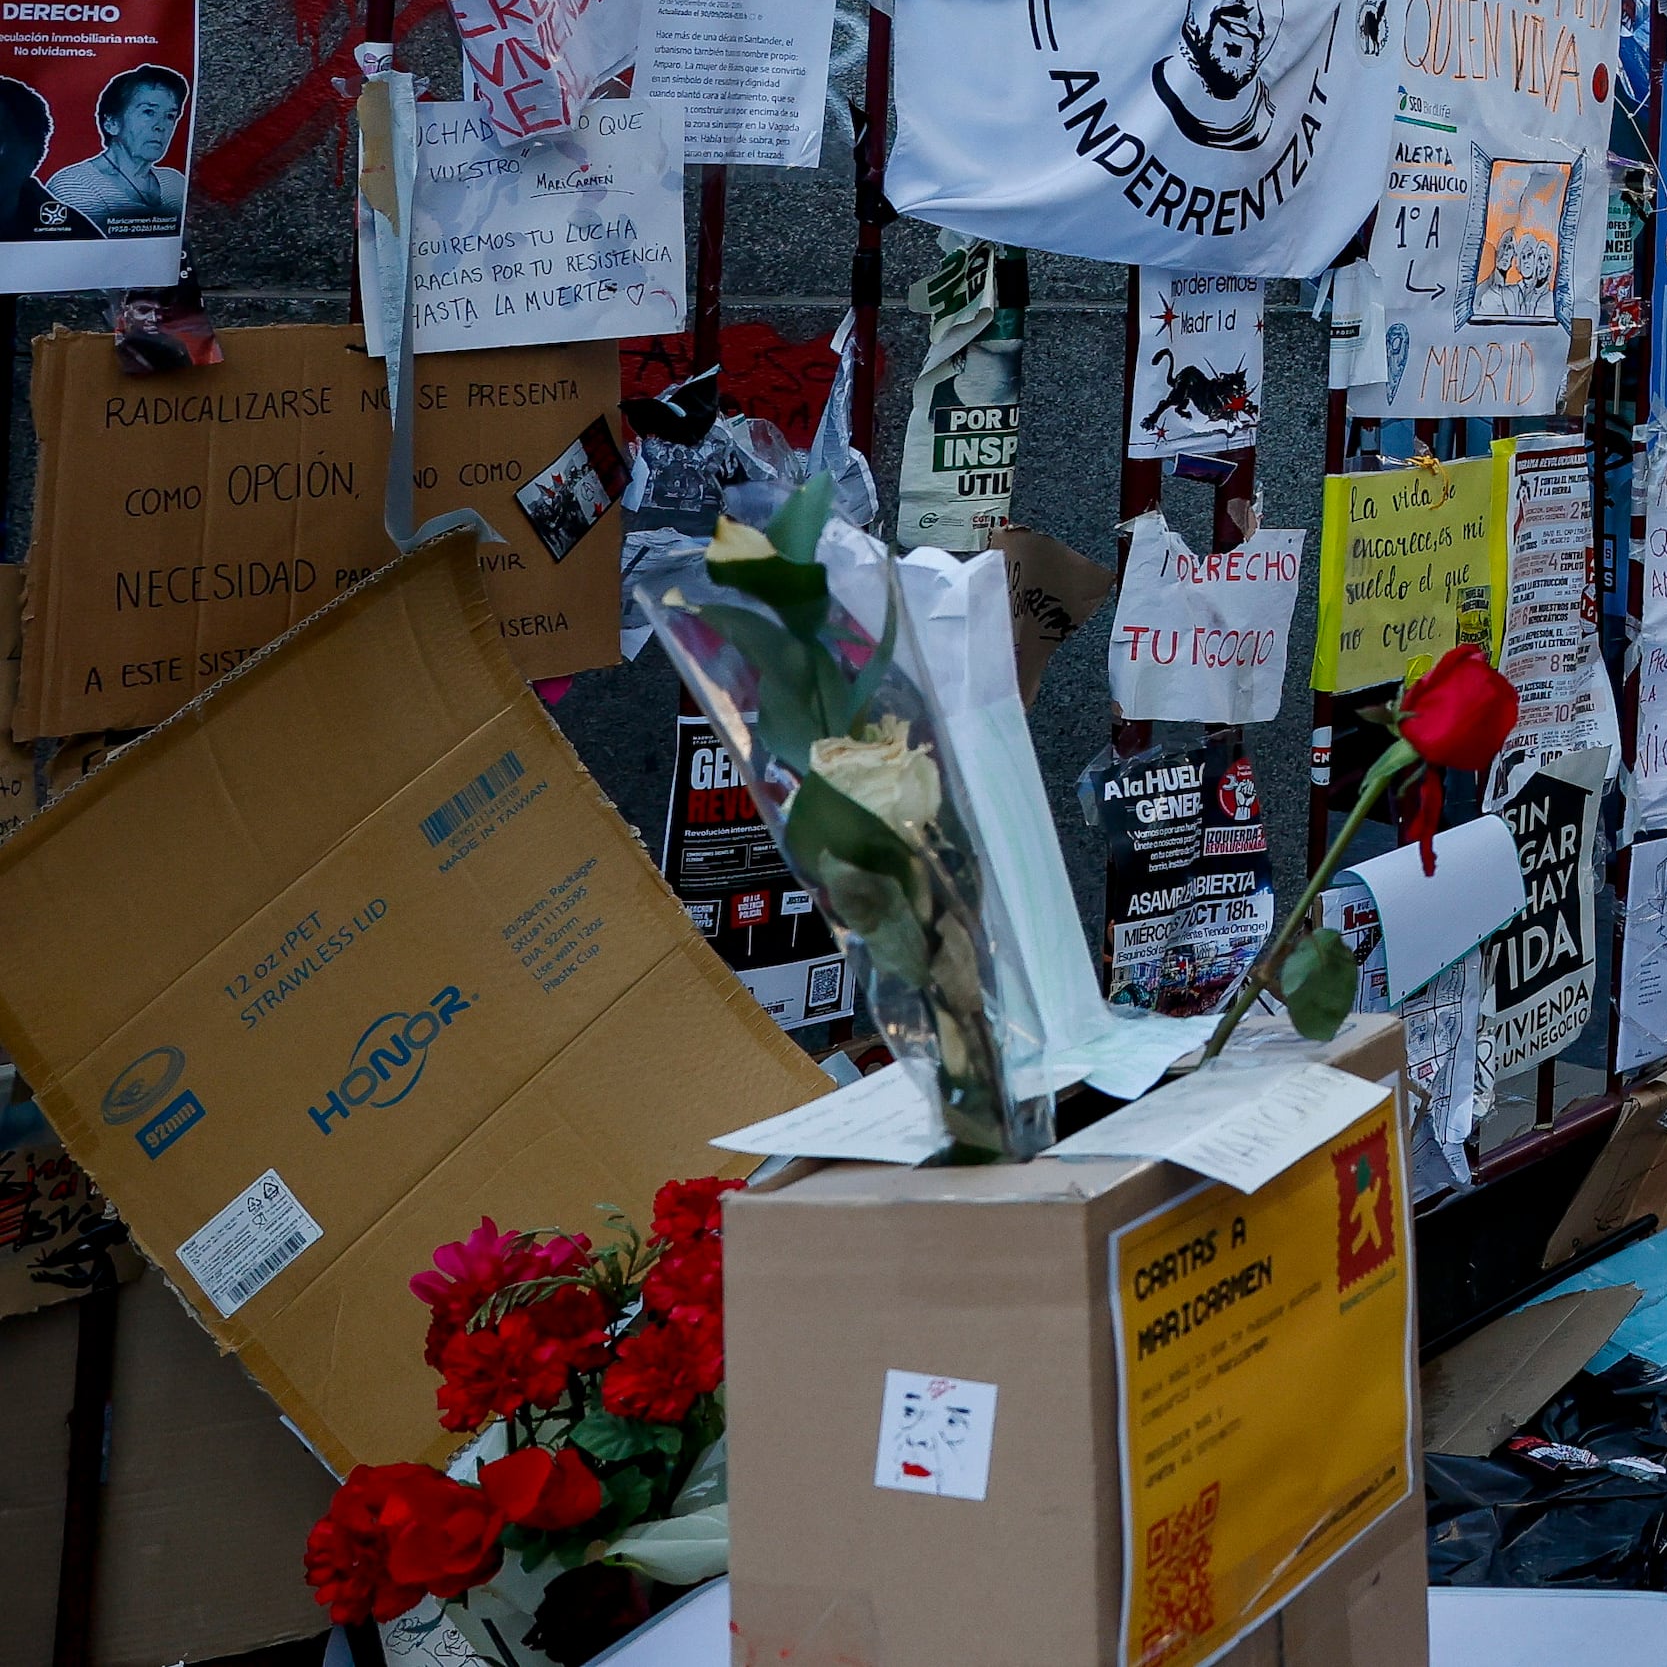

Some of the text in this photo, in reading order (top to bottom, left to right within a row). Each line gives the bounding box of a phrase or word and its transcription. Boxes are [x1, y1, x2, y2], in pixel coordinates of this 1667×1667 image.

[3, 3, 120, 22] DERECHO
[14, 45, 96, 57] No olvidamos.
[52, 33, 158, 45] inmobiliaria mata.
[1511, 7, 1583, 117] VIVA
[1409, 93, 1423, 113] SEO
[600, 112, 644, 135] QUE
[1049, 68, 1330, 237] ANDERRENTZAT
[1395, 142, 1453, 167] ALERTA
[526, 219, 638, 246] TU LUCHA
[1425, 205, 1441, 249] A
[492, 260, 522, 282] POR
[530, 259, 552, 276] TU
[495, 292, 515, 316] LA
[1180, 309, 1237, 334] Madrid
[1420, 340, 1537, 406] MADRID
[106, 379, 580, 428] RADICALIZARSE SE PRESENTA
[950, 409, 1002, 431] POR
[124, 485, 200, 518] COMO
[459, 460, 523, 487] COMO
[958, 471, 1011, 497] ÚTIL
[1350, 478, 1433, 523] La vida
[1463, 515, 1486, 541] mi
[116, 559, 316, 612] NECESIDAD
[1177, 553, 1297, 584] DERECHO
[1346, 563, 1470, 606] sueldo el que
[1122, 625, 1179, 666] TU
[1339, 616, 1442, 651] no crece.
[84, 657, 182, 695] A ESTE
[1640, 685, 1656, 703] LA
[1104, 777, 1146, 801] A la
[438, 840, 481, 875] MADE
[497, 781, 550, 827] TAIWAN
[1504, 796, 1550, 836] SIN
[1519, 824, 1577, 875] GAR
[1226, 899, 1258, 922] 18h.
[224, 911, 323, 1001] 12 oz rPET
[240, 897, 389, 1030] STRAWLESS LID
[1503, 1007, 1588, 1069] UN NEGOCIO
[307, 985, 471, 1135] HONOR
[142, 1101, 199, 1152] 92mm
[1134, 1216, 1246, 1302] CARTAS A
[1138, 1255, 1273, 1361] MARICARMEN
